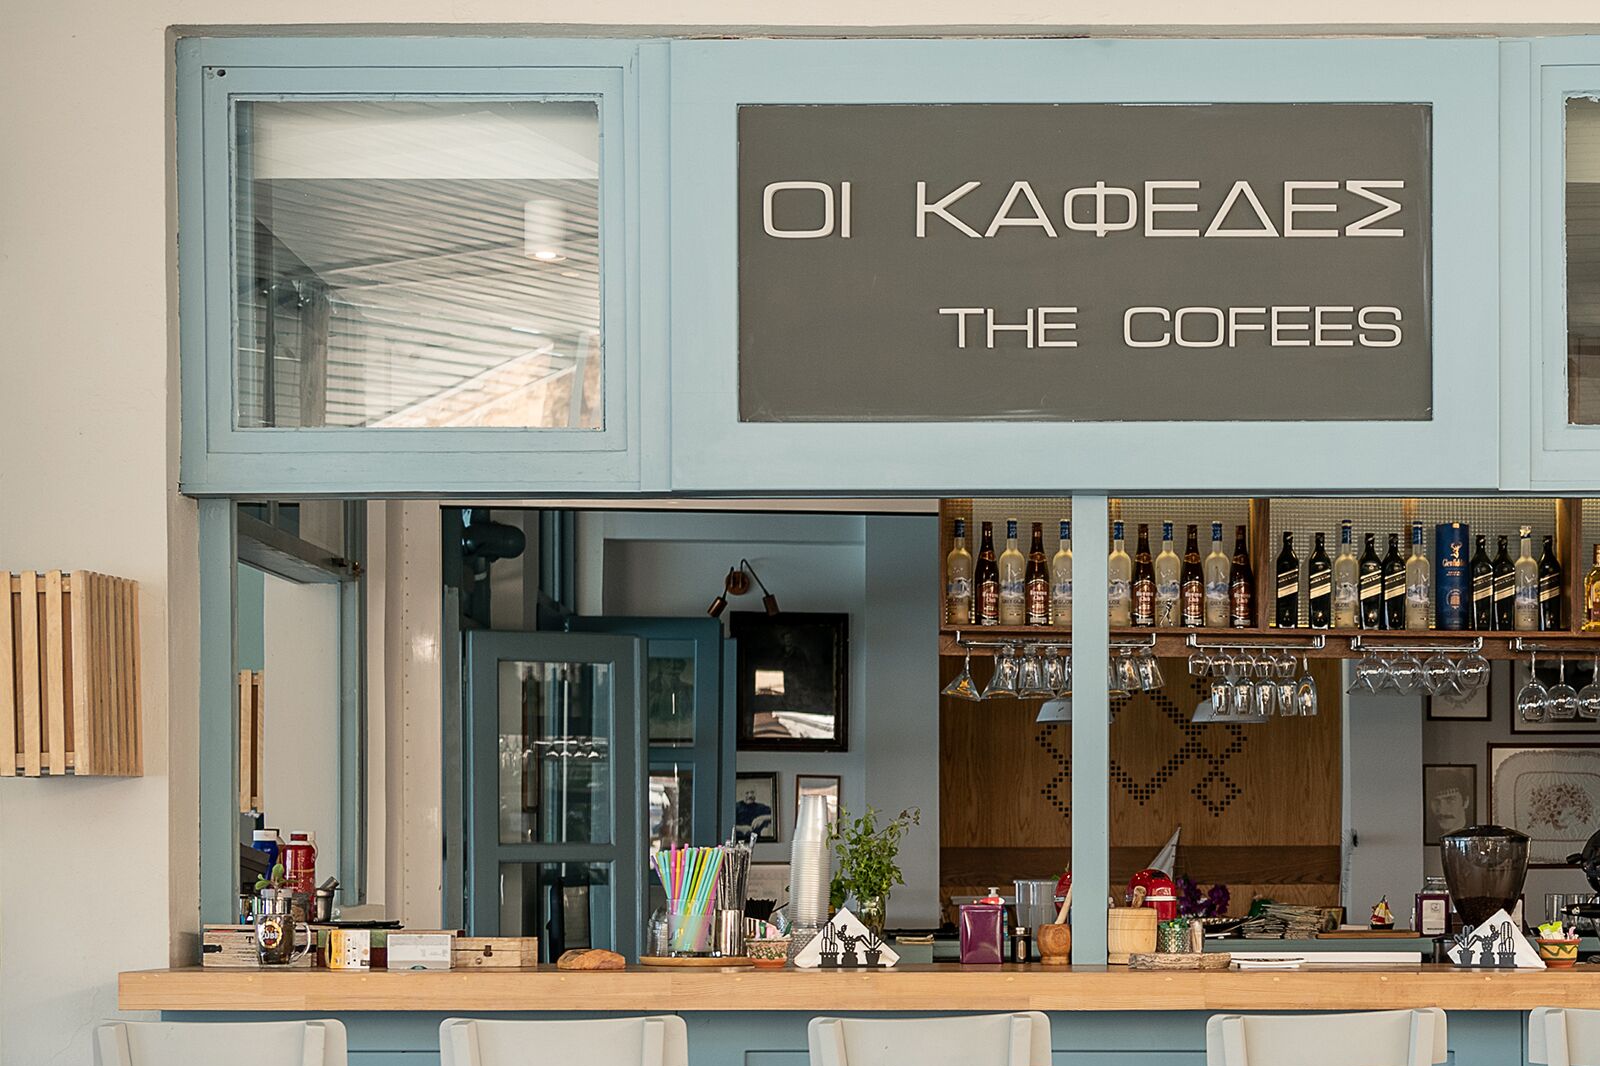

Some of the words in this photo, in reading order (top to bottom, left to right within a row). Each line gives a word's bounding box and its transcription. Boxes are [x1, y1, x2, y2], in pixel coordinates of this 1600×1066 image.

[762, 181, 851, 239] ΟΙ
[915, 180, 1405, 239] ΚΑΦΕΔΕΣ
[939, 306, 1078, 349] THE
[1123, 305, 1404, 349] COFEES
